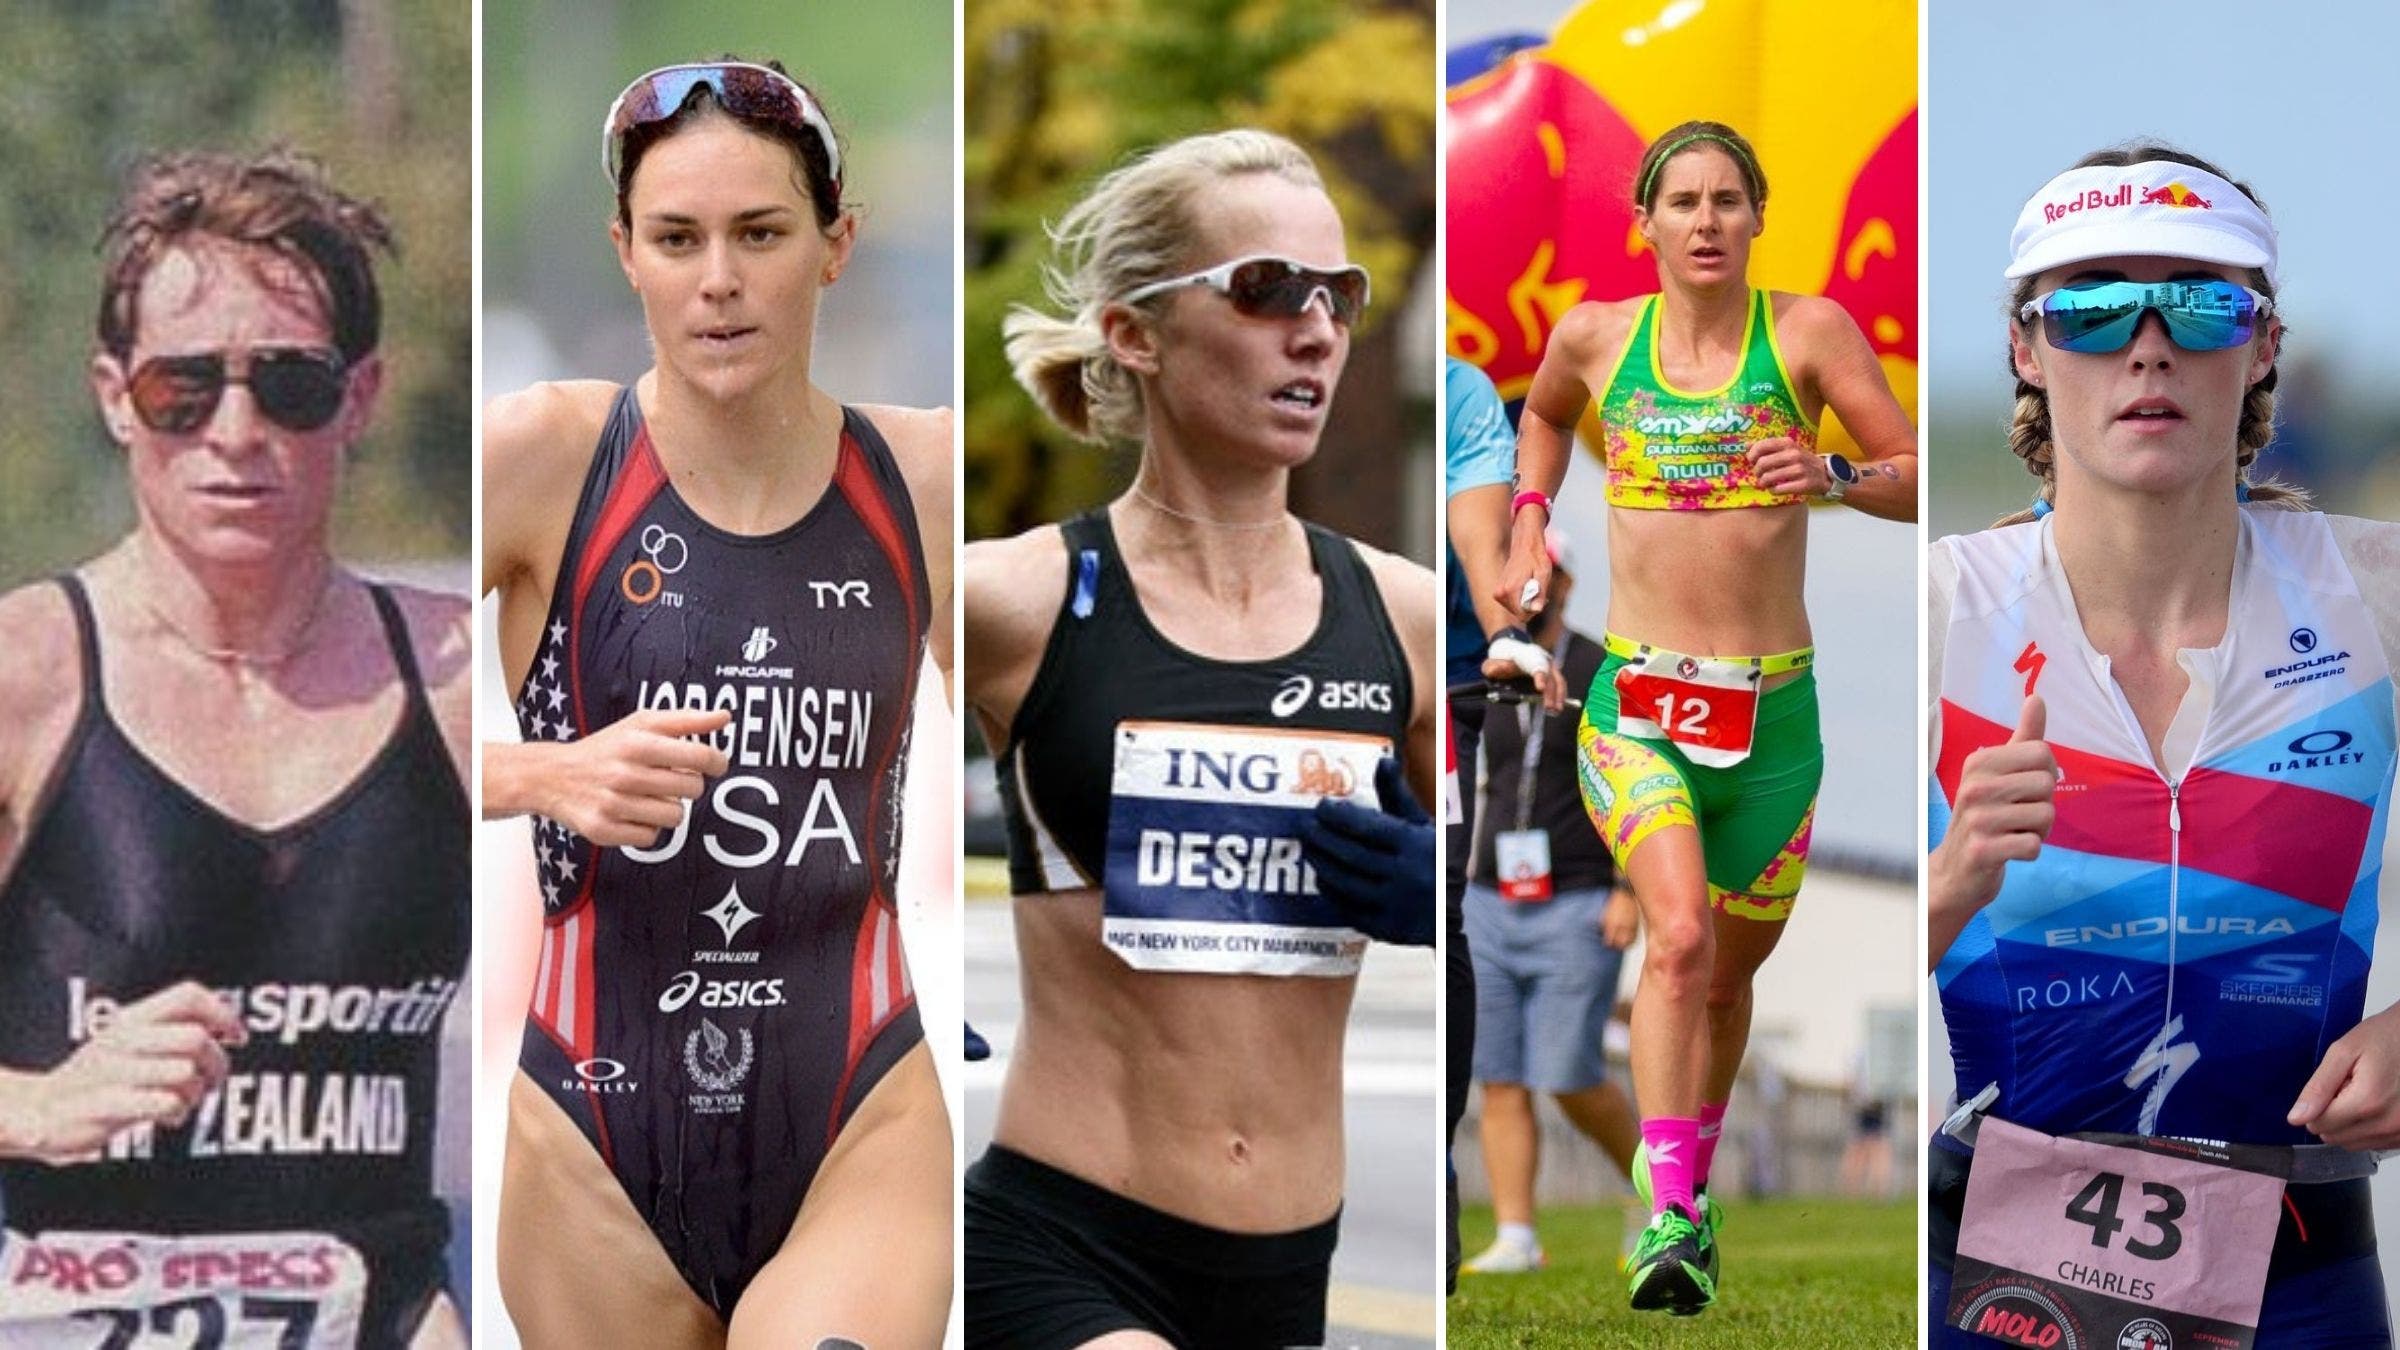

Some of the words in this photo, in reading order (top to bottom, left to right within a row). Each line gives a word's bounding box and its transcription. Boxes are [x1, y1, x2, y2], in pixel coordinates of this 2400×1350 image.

[2043, 192, 2084, 224] Red
[2087, 184, 2132, 210] Bull
[1660, 462, 1728, 479] nuun
[660, 591, 684, 608] ITU
[808, 580, 873, 609] TYR
[715, 664, 794, 679] HINCAPIE
[2264, 651, 2351, 679] ENDURA
[1318, 681, 1392, 713] asics
[1654, 692, 1711, 736] 12
[1163, 748, 1281, 794] ING
[2267, 752, 2364, 773] OAKLEY
[1138, 933, 1176, 950] NEW
[1181, 934, 1221, 951] YORK
[1226, 936, 1260, 952] CITY
[2045, 915, 2296, 947] ENDURA
[2220, 980, 2322, 998] SKECHERS
[2220, 992, 2322, 1007] PERFORMANCE
[562, 1080, 638, 1093] OAKLEY
[190, 1074, 407, 1157] ZEALAND
[2065, 1171, 2187, 1261] 43
[15, 1248, 140, 1293] PRO
[162, 1245, 336, 1289] SPECS
[2057, 1260, 2155, 1301] CHARLES
[1976, 1305, 2062, 1348] MOLO
